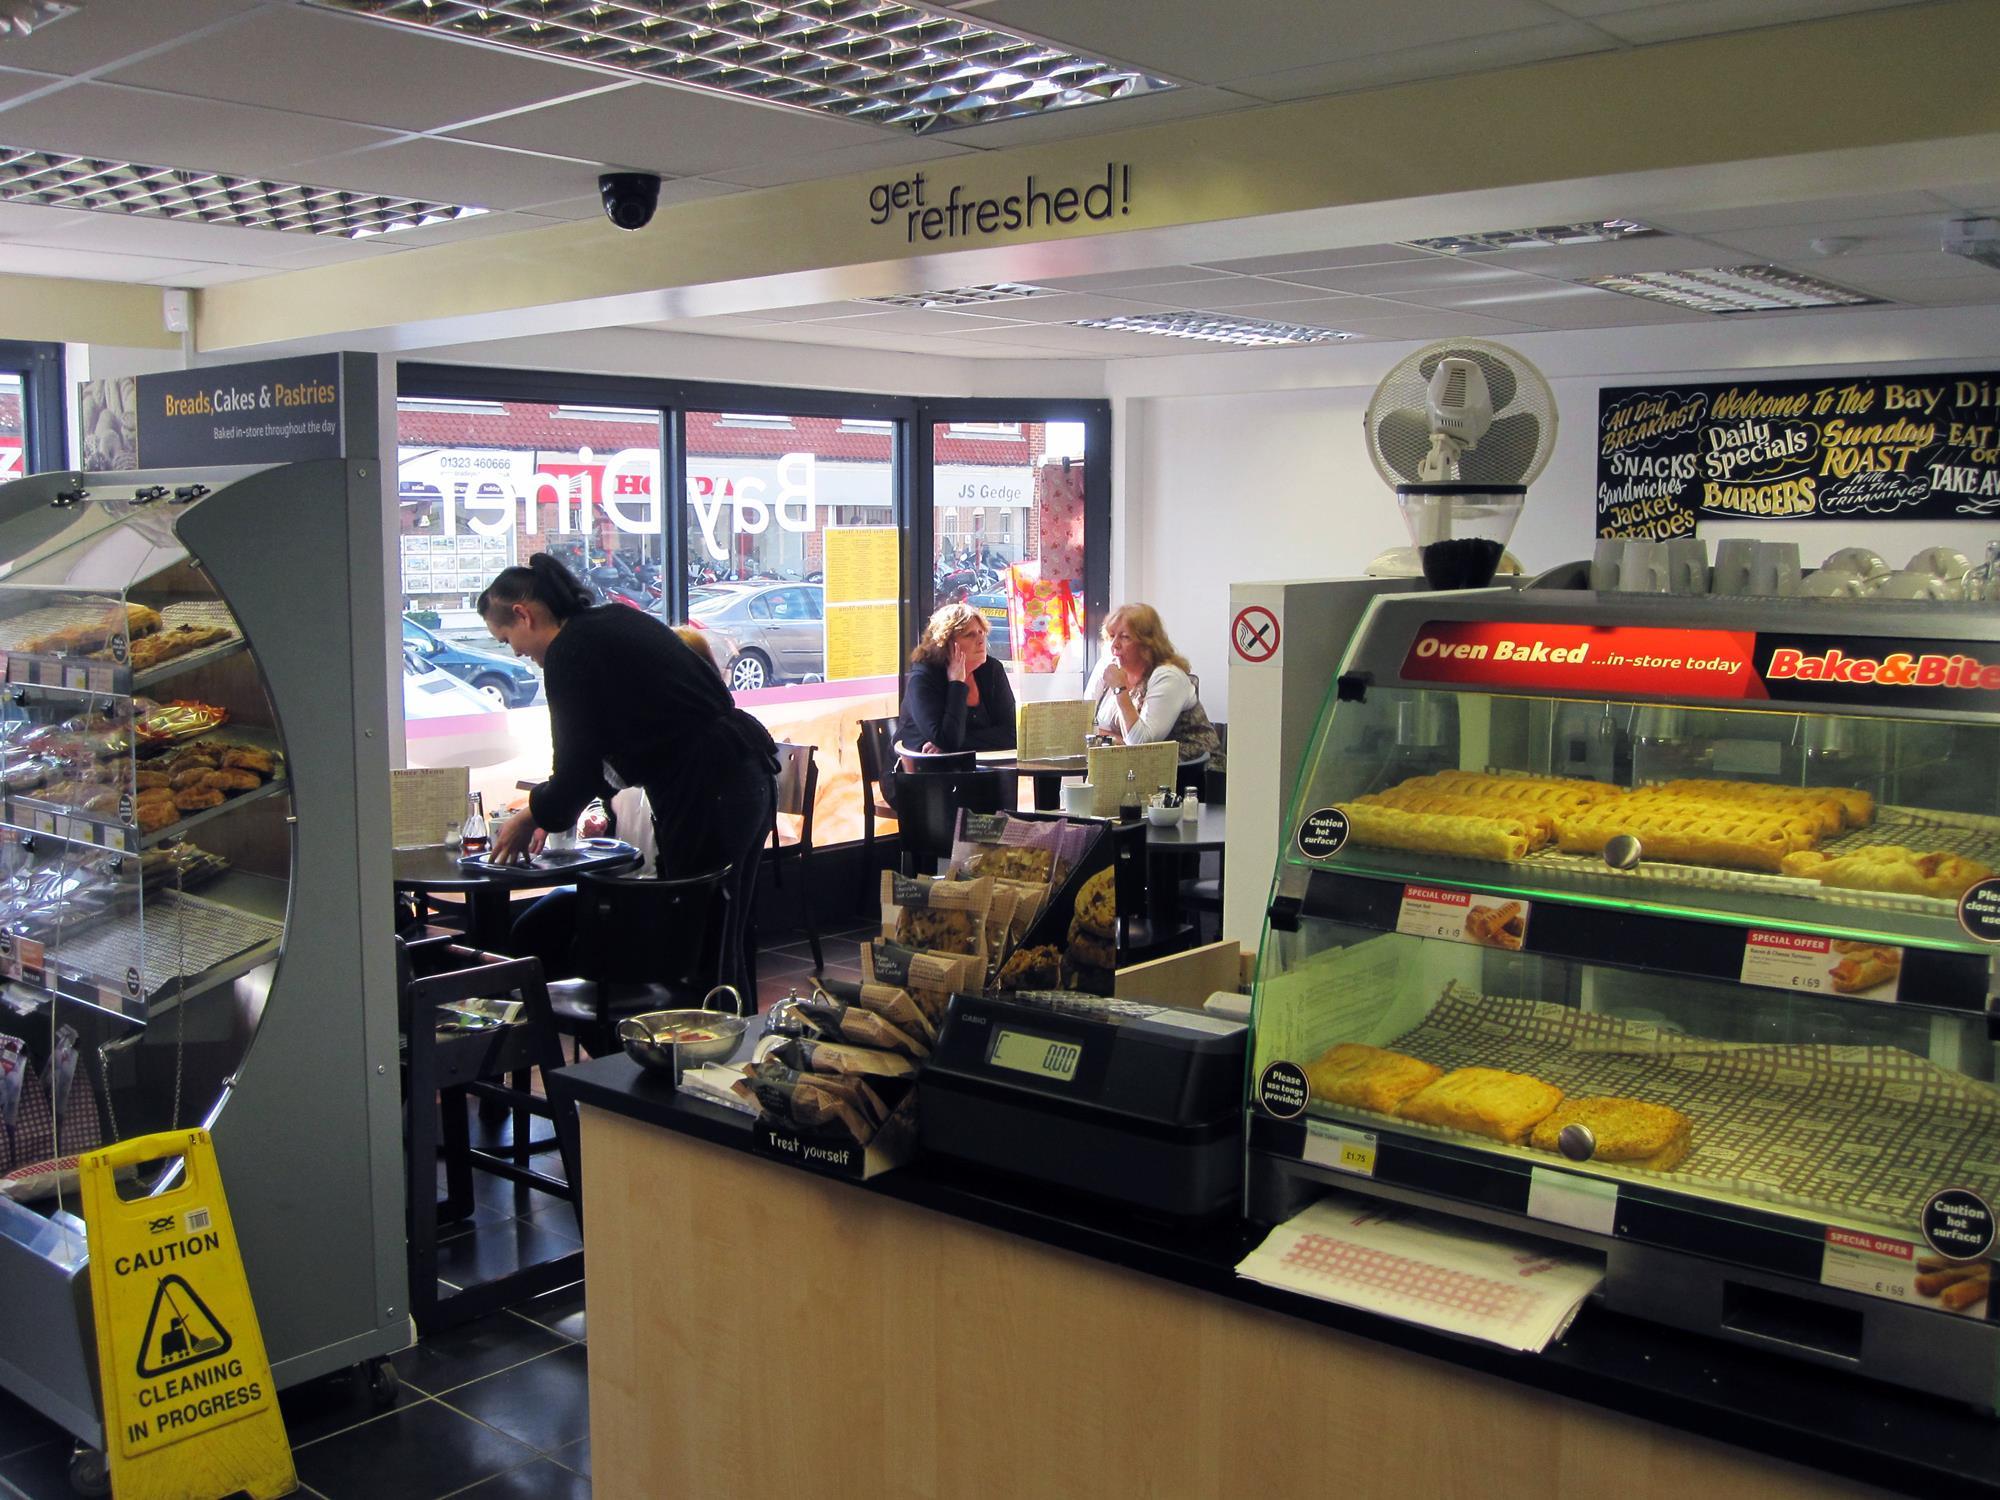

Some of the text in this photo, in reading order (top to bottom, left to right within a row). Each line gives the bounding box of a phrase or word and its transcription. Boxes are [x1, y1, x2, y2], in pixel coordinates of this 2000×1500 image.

[869, 172, 926, 224] get
[907, 162, 1130, 243] refreshed!
[259, 384, 271, 408] &
[274, 379, 335, 407] Pastries
[1710, 387, 1811, 420] Welcome
[1812, 387, 1837, 415] To
[1836, 383, 1876, 415] The
[1885, 384, 1946, 415] Bay
[1601, 399, 1704, 455] BREAKFAST
[1606, 398, 1669, 431] All Day
[213, 418, 336, 440] Baked in-store throughout the day
[1708, 419, 1771, 452] Daily
[1821, 416, 1936, 449] Sunday
[1948, 422, 1993, 448] EAT
[440, 456, 471, 469] 01323
[1610, 452, 1696, 479] SNACKS
[1705, 428, 1808, 479] Specials
[1819, 446, 1921, 479] ROAST
[1971, 448, 1999, 465] OR
[1838, 479, 1900, 496] ALL THE
[1929, 464, 1979, 494] TAKE
[958, 484, 1022, 503] JS Gedge
[1598, 476, 1688, 514] Sandwiches
[1826, 484, 1928, 507] TRIMMINGS
[1610, 494, 1679, 528] Jacket
[1416, 637, 1488, 661] Oven
[1493, 640, 1590, 665] Baked
[1685, 655, 1743, 676] today
[1767, 647, 2000, 692] Bake&Bite
[1308, 817, 1344, 829] Caution
[1315, 827, 1330, 836] hot
[1304, 836, 1338, 847] surface!
[1407, 888, 1467, 904] SPECIAL OFFER
[1965, 901, 1996, 913] close
[1752, 933, 1825, 950] SPECIAL OFFER
[1266, 1081, 1304, 1098] use tongs
[1272, 1070, 1302, 1086] Please
[1264, 1091, 1303, 1107] provided!
[769, 1132, 850, 1165] Treat yourself
[1346, 1151, 1367, 1163] £1.75
[1933, 1200, 1986, 1219] Caution
[1946, 1216, 1968, 1229] hot
[1830, 1232, 1872, 1248] SPECIAL
[1875, 1241, 1909, 1256] OFFER
[1932, 1226, 1982, 1245] surface!
[115, 1231, 220, 1277] CAUTION
[138, 1359, 243, 1408] CLEANING
[128, 1383, 262, 1443] IN PROGRESS
